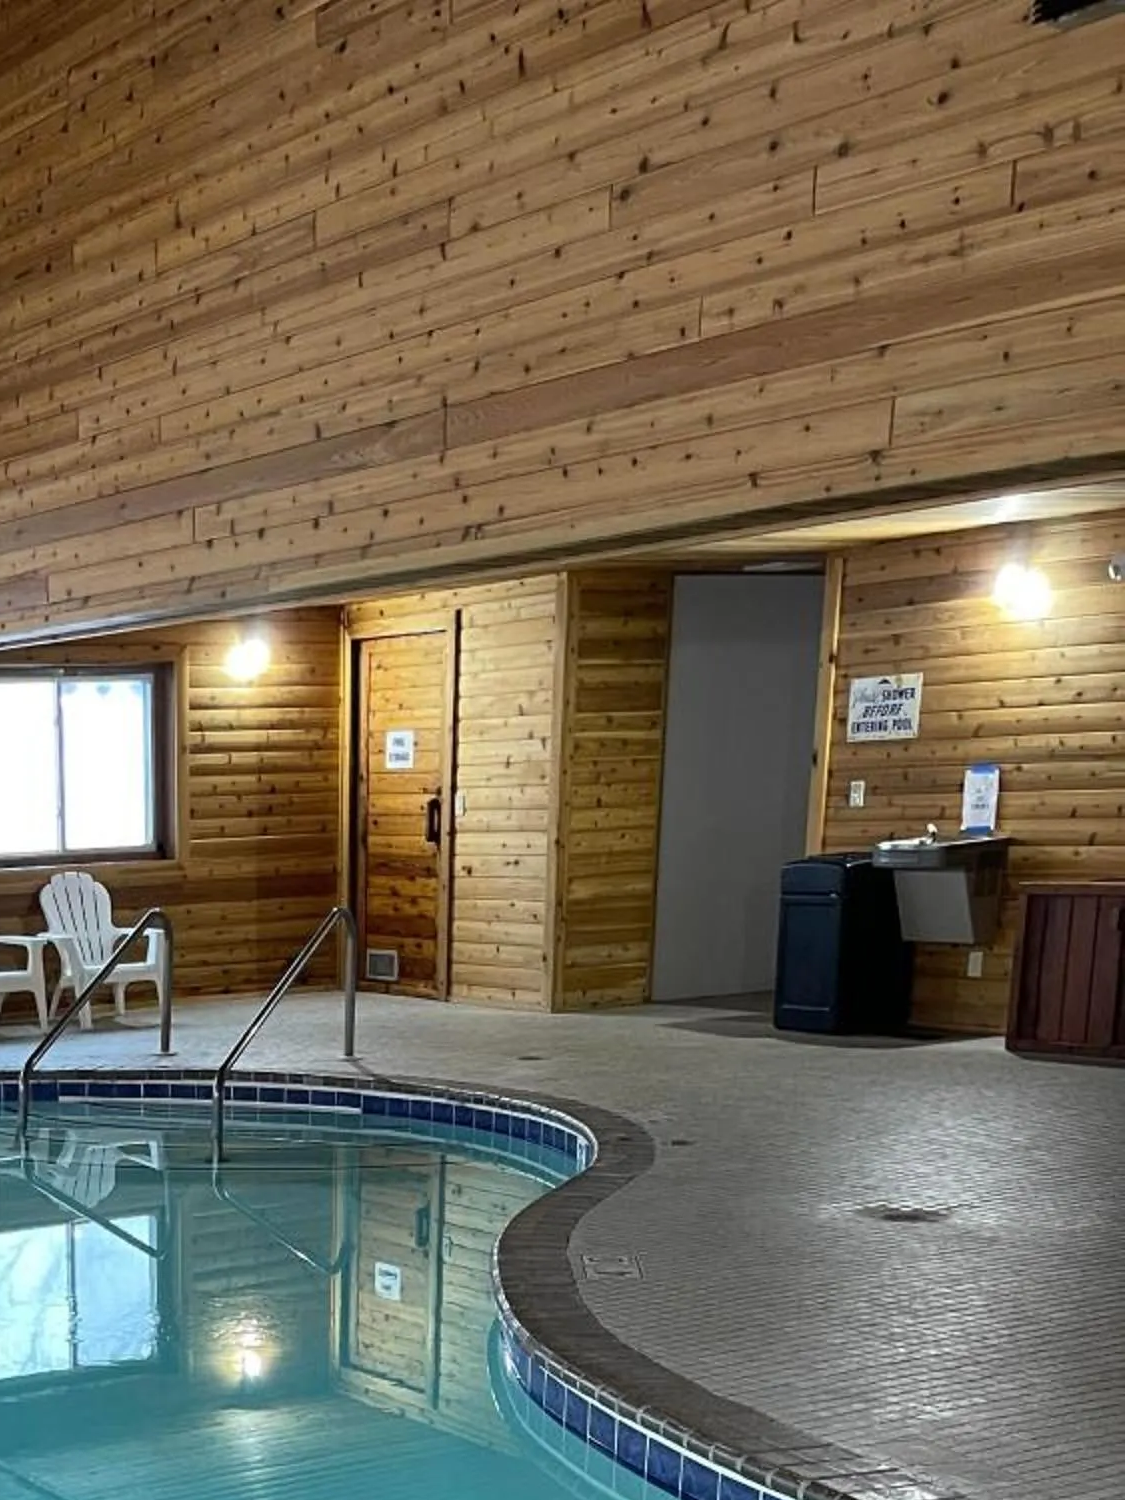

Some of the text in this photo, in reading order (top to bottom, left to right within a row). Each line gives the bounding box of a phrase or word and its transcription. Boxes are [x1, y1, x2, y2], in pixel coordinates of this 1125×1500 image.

[881, 687, 916, 702] SHOWER
[863, 703, 903, 718] BEFORE
[851, 718, 912, 734] ENTERING POOL
